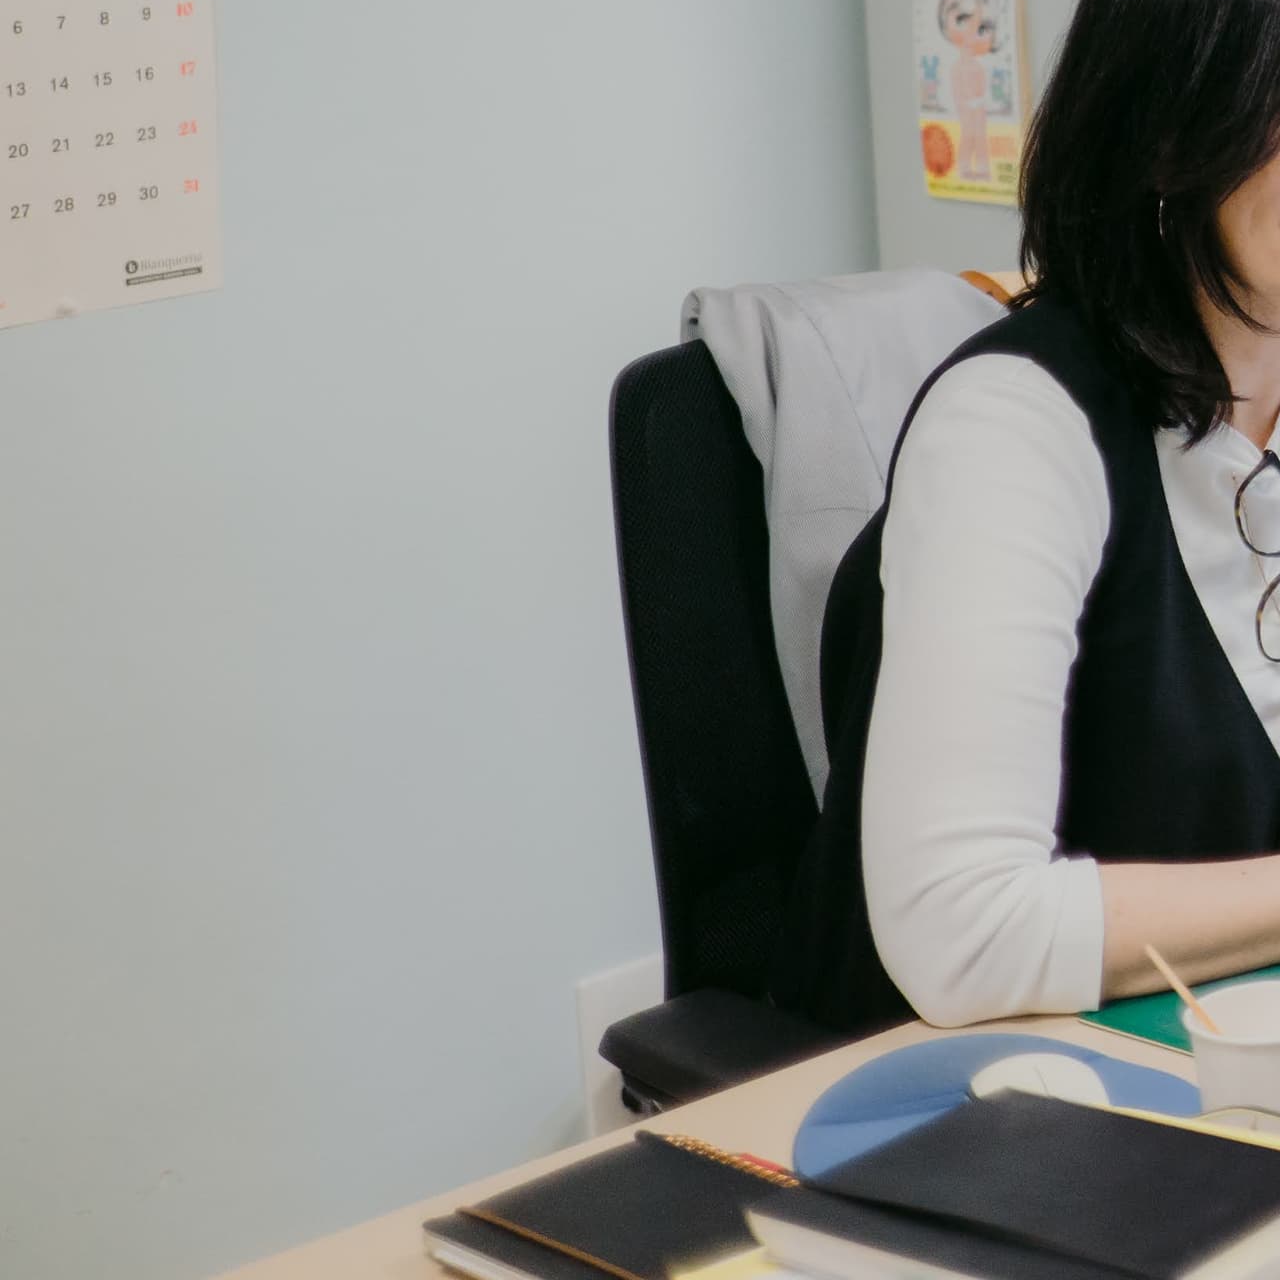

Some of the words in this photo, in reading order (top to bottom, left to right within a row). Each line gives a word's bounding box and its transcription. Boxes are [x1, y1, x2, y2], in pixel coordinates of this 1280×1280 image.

[13, 20, 23, 34] 6
[56, 16, 66, 29] 7
[100, 11, 110, 25] 8
[142, 7, 151, 20] 9
[6, 82, 27, 98] 13
[51, 77, 69, 92] 14
[94, 72, 113, 88] 15
[136, 66, 154, 82] 16
[180, 61, 196, 76] 17
[8, 143, 29, 159] 20
[52, 138, 70, 153] 21
[95, 132, 115, 148] 22
[137, 126, 157, 142] 23
[10, 203, 30, 220] 27
[54, 197, 75, 213] 28
[97, 192, 117, 207] 29
[139, 185, 159, 201] 30
